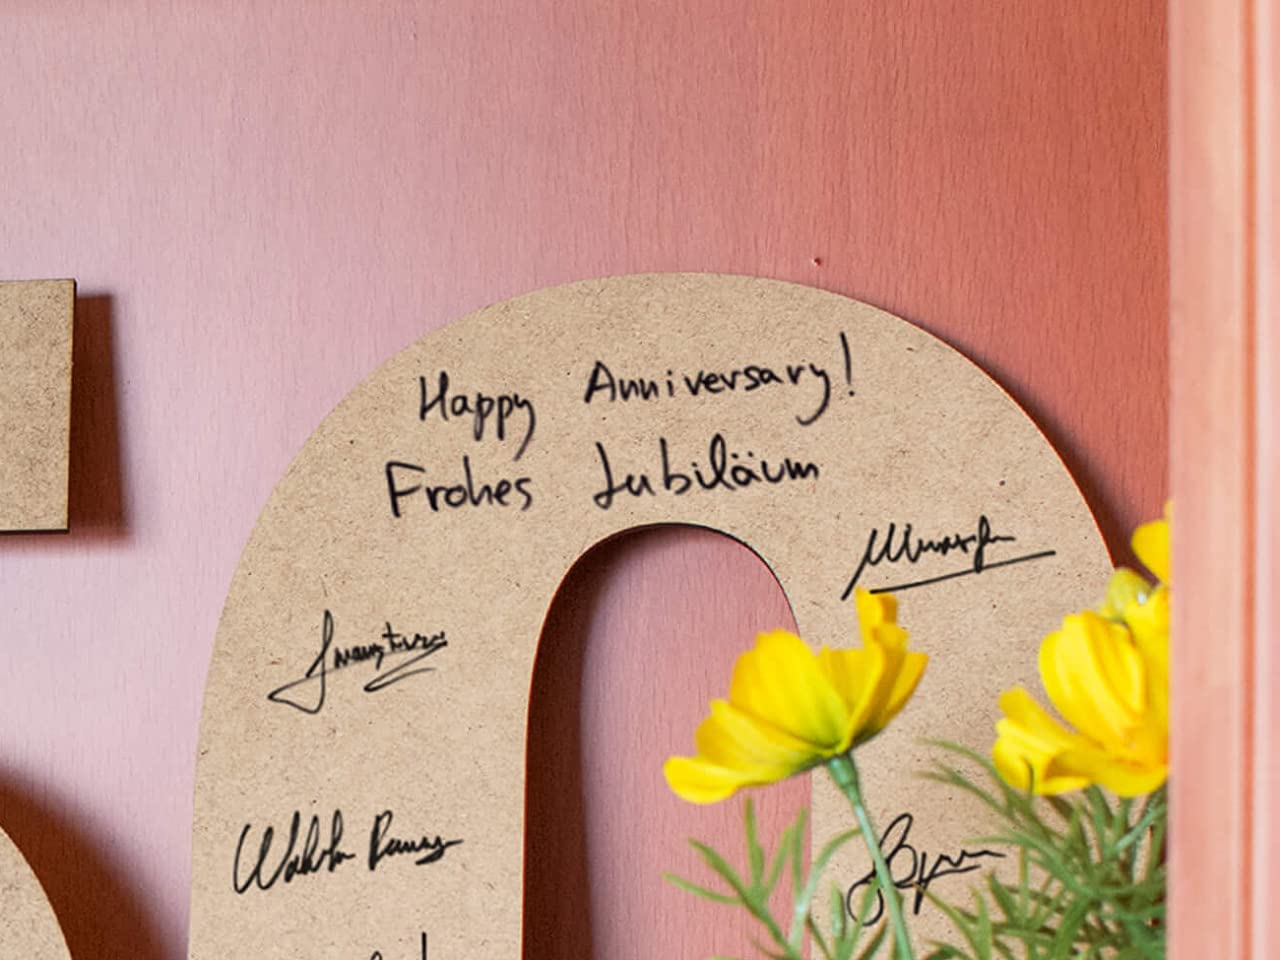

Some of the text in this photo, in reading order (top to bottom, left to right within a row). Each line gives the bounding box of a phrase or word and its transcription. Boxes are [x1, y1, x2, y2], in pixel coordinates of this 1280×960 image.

[417, 330, 857, 462] Happy Anniversary!
[384, 432, 821, 519] Frohes Jubiläum
